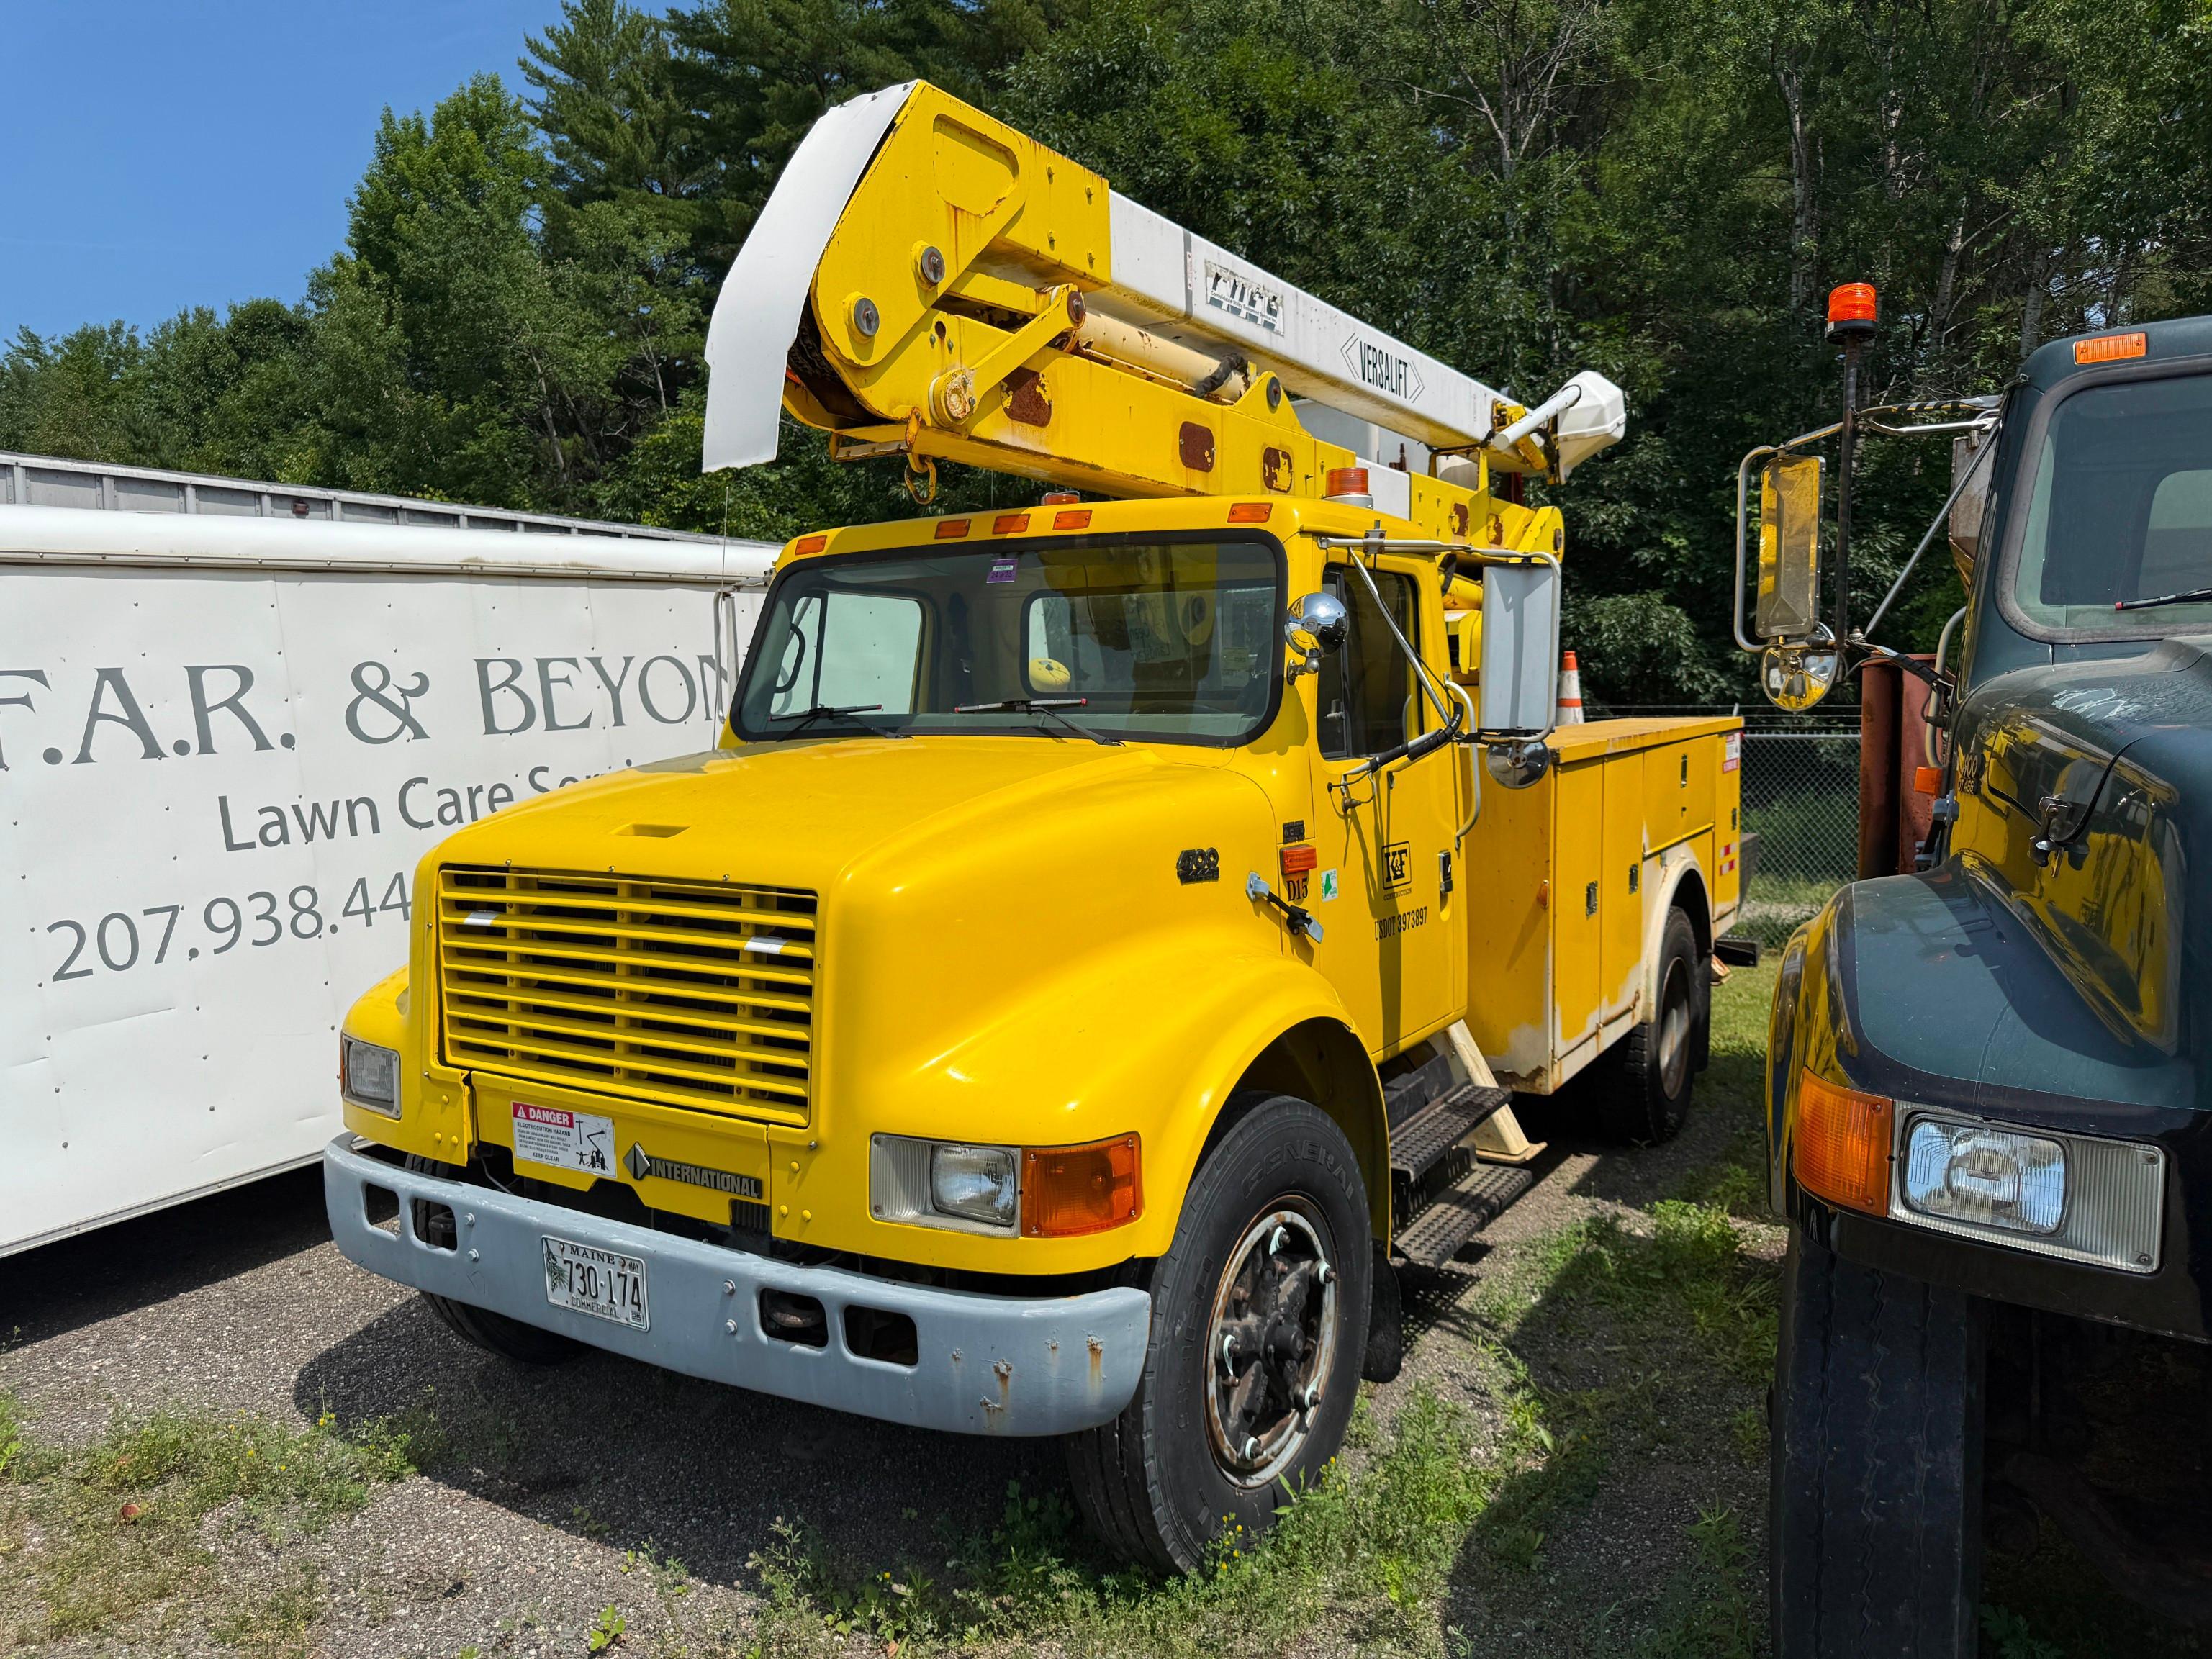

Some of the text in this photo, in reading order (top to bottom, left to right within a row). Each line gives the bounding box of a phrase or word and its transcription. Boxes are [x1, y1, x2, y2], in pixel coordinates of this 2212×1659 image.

[1360, 340, 1408, 399] VERSALIFT
[345, 661, 430, 745] &
[474, 654, 728, 736] BEYON
[218, 777, 514, 852] Lawn Care
[1385, 849, 1408, 882] K&F
[1286, 877, 1309, 902] D15
[47, 872, 411, 982] 207.938.44
[1375, 906, 1427, 941] USDOT 3973897
[518, 1122, 571, 1136] ELECTROCUTION HAZARD
[529, 1108, 569, 1126] DANGER
[651, 1159, 760, 1198] INTERNATIONAL
[570, 1246, 615, 1265] MAINE
[628, 1262, 639, 1271] MAY
[571, 1296, 619, 1317] COMMERCIAL
